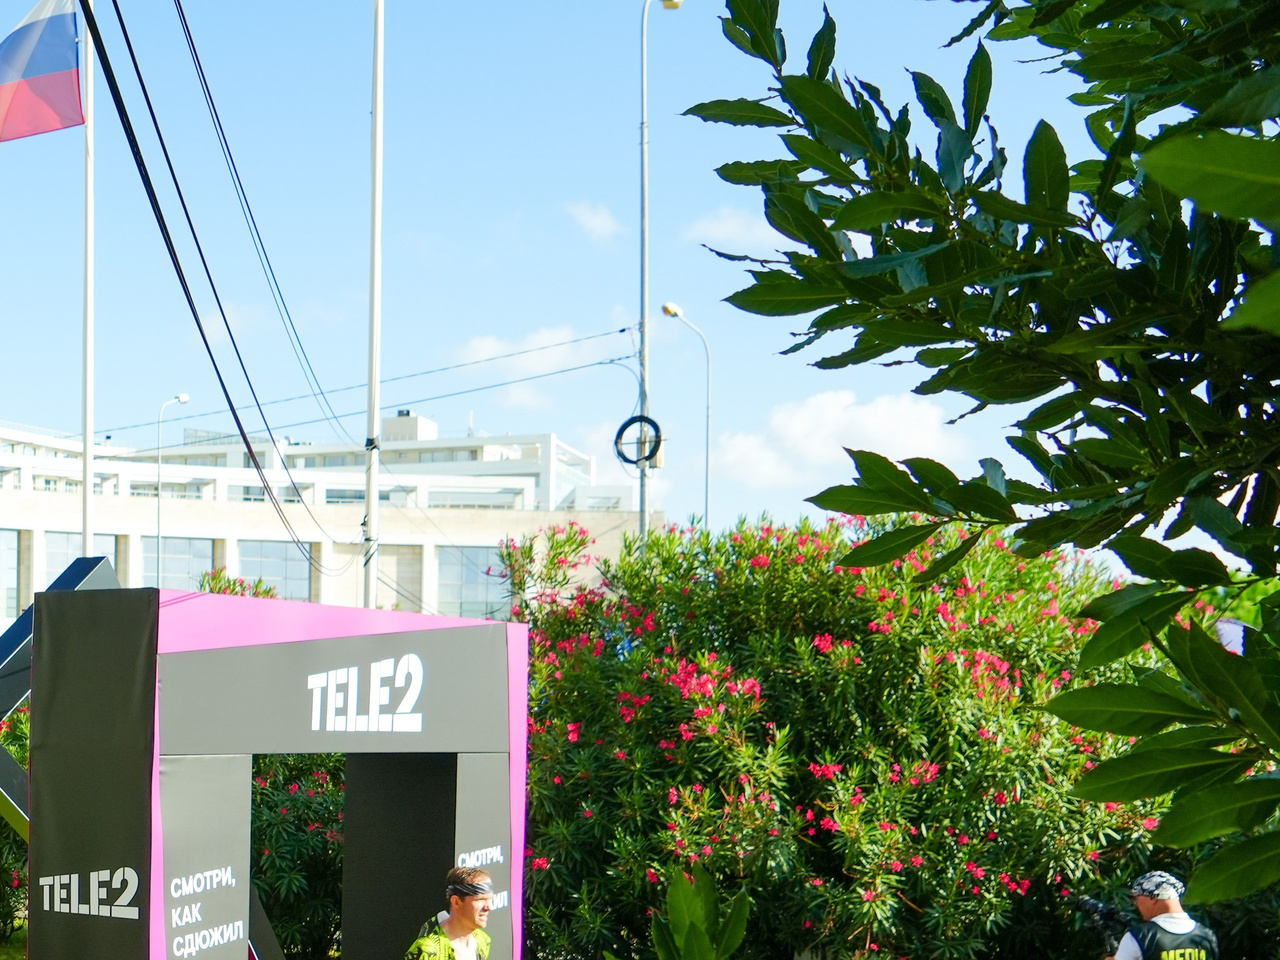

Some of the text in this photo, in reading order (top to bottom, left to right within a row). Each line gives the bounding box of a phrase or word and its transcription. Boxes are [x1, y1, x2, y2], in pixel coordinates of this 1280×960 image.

[308, 653, 423, 732] TELE2
[458, 845, 504, 868] СМОТРИ,
[39, 867, 139, 920] TELE2
[170, 866, 236, 898] СМОТРИ,
[171, 902, 202, 928] КАК
[172, 920, 243, 958] СДЮЖИЛ
